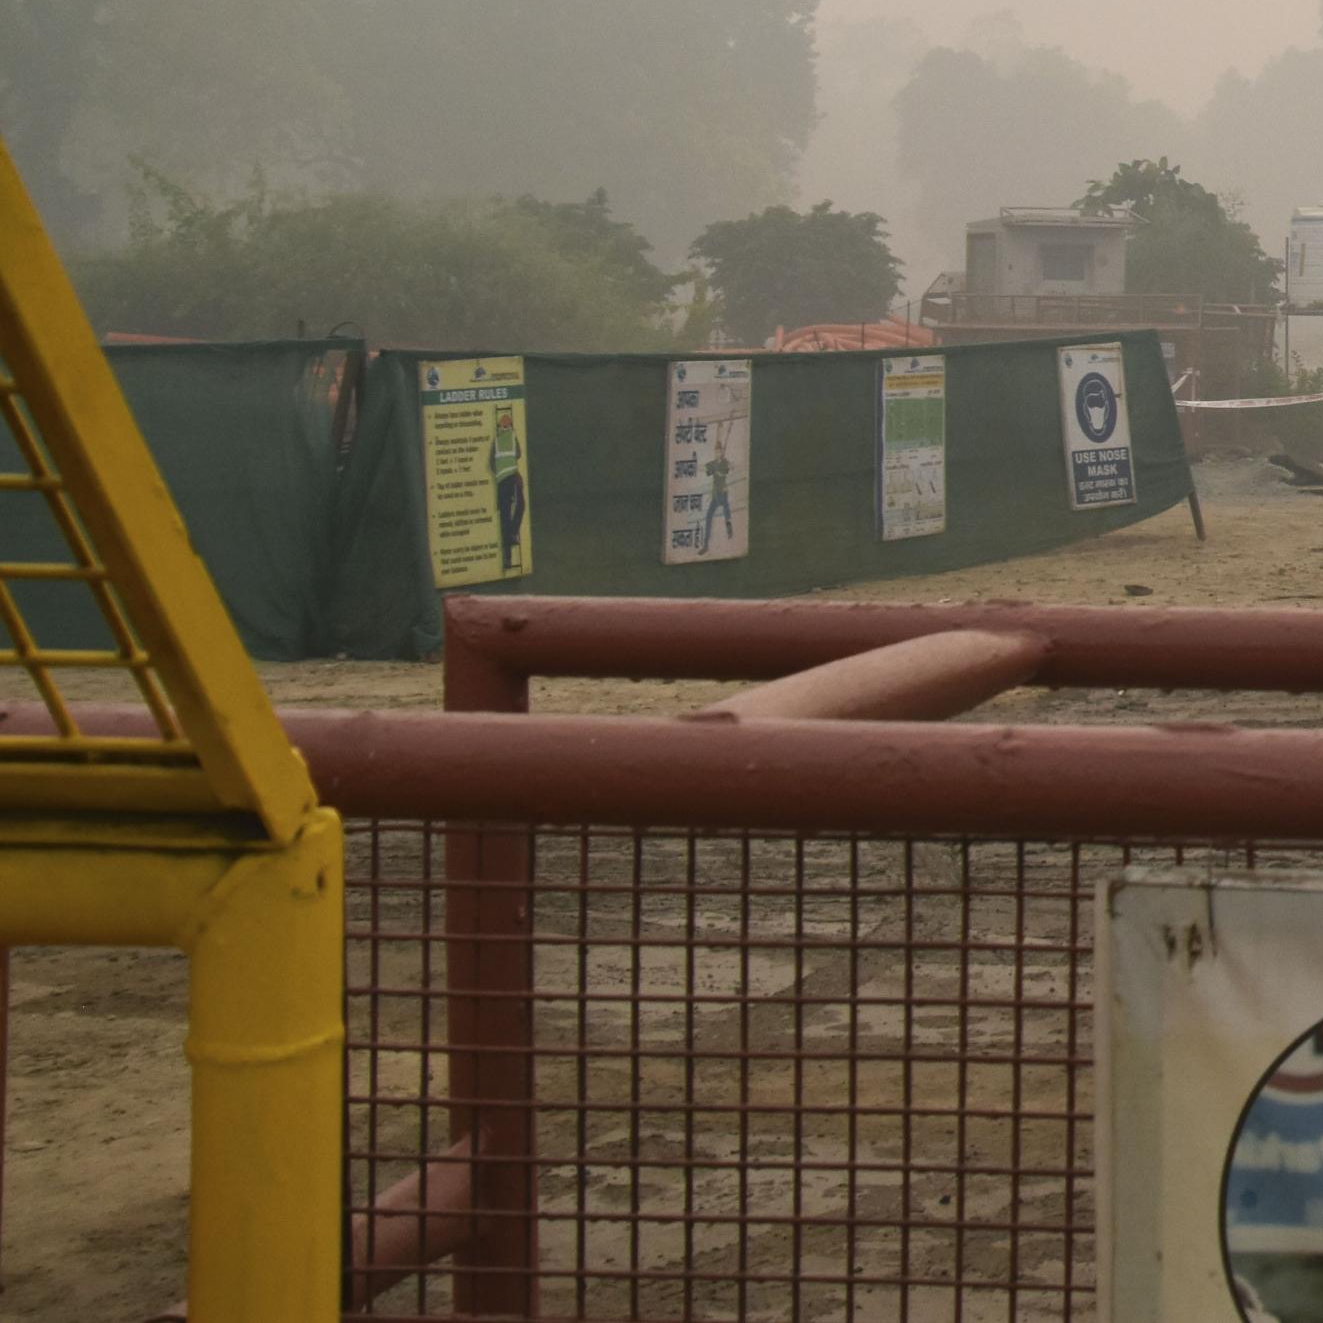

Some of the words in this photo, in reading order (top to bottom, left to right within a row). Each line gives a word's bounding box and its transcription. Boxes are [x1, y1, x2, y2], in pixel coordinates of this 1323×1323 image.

[440, 390, 476, 402] LADDER
[478, 387, 508, 401] RULES
[1076, 452, 1096, 463] USE
[1099, 449, 1128, 462] NOSE
[1088, 464, 1117, 476] MASK
